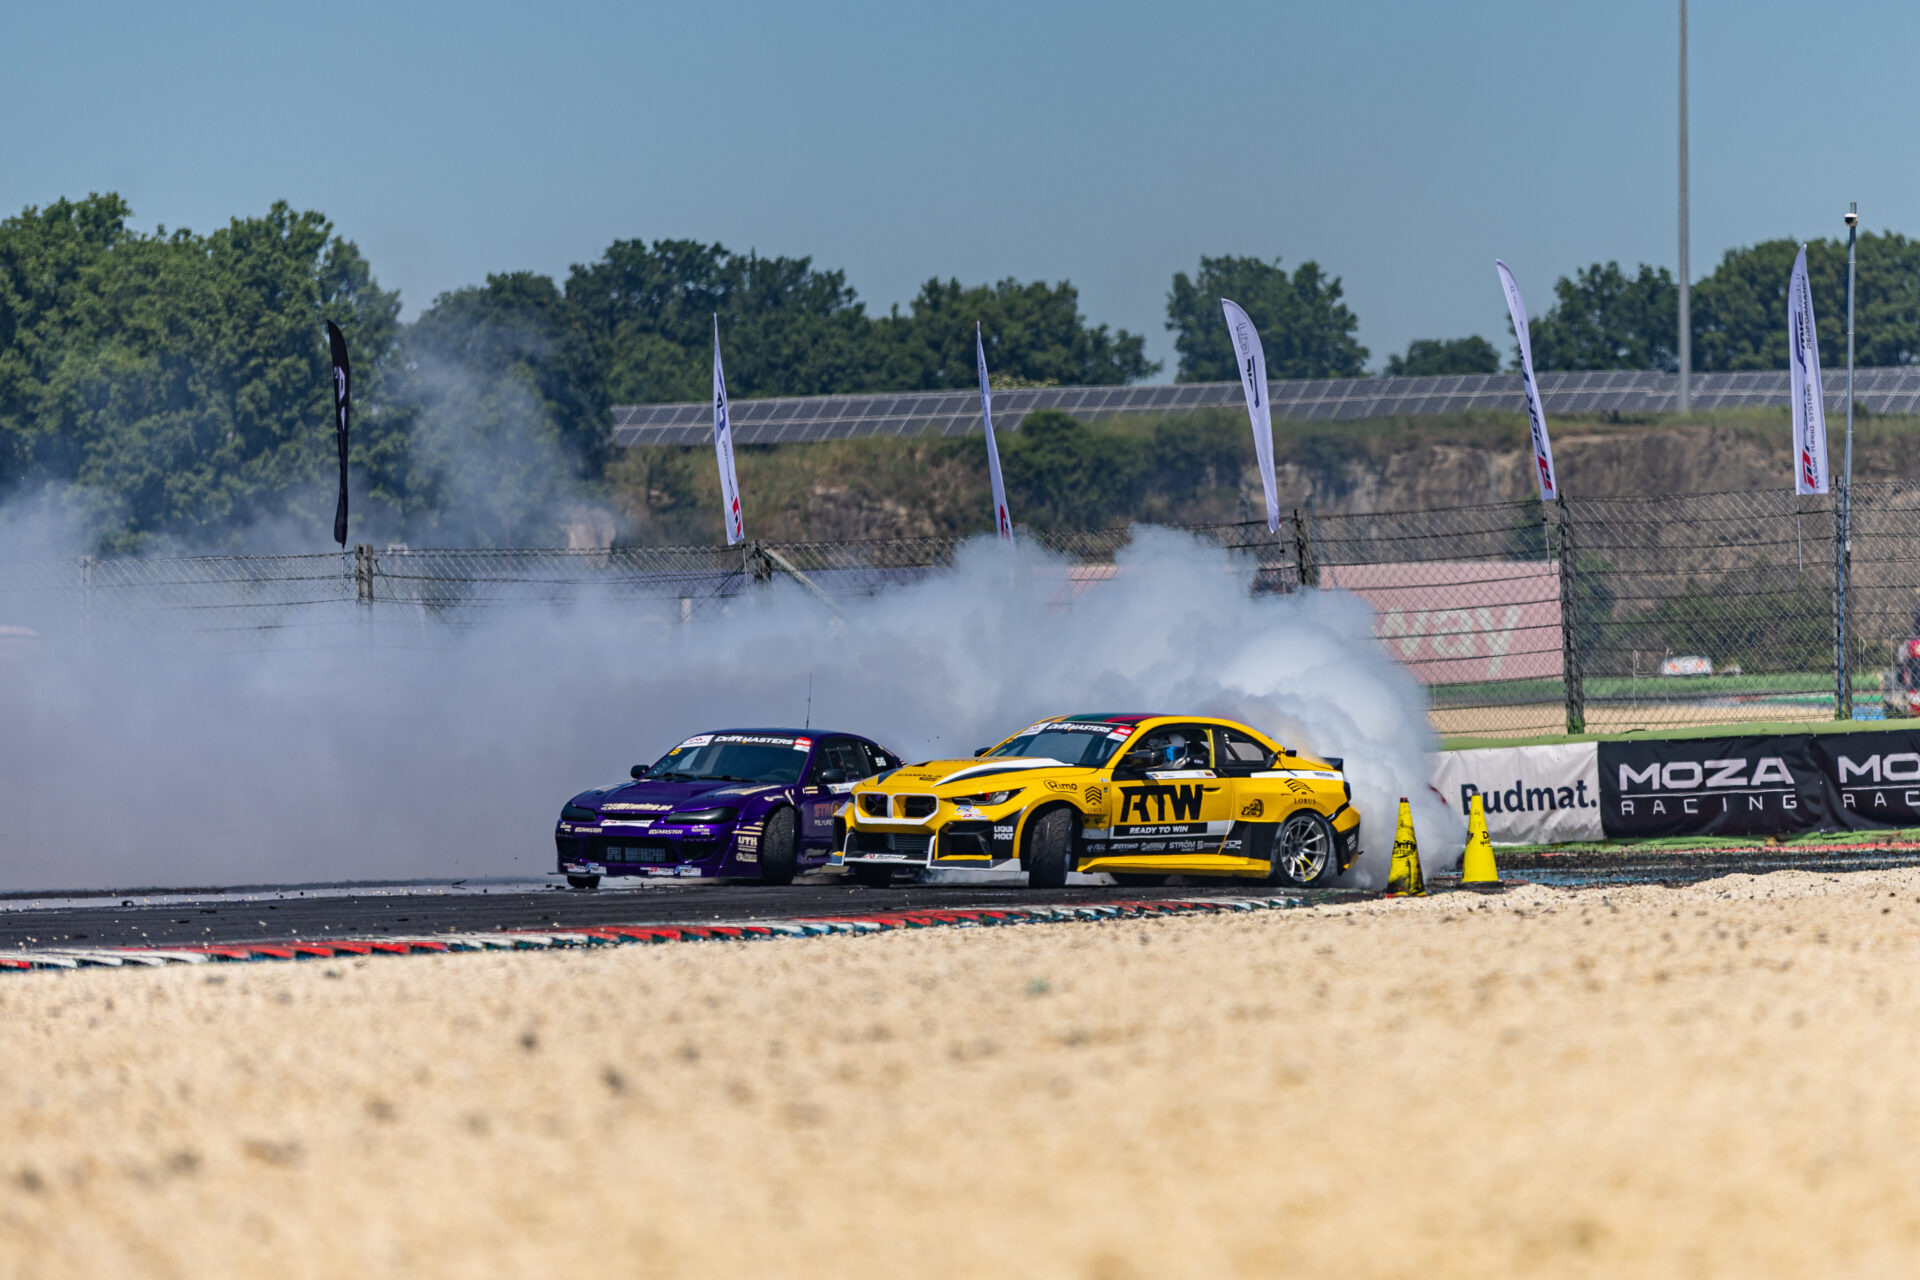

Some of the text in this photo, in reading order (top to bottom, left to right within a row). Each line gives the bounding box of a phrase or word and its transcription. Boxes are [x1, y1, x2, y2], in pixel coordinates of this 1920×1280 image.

[1618, 757, 1796, 790] MOZA
[1049, 780, 1078, 792] Rimo
[1119, 784, 1204, 822] RTW
[1294, 797, 1317, 805] LORUS
[1621, 794, 1798, 816] RACING
[994, 825, 1014, 833] LIQUI
[1129, 825, 1189, 835] READY TO WIN
[738, 836, 758, 846] UTH
[994, 833, 1014, 841] MOLY
